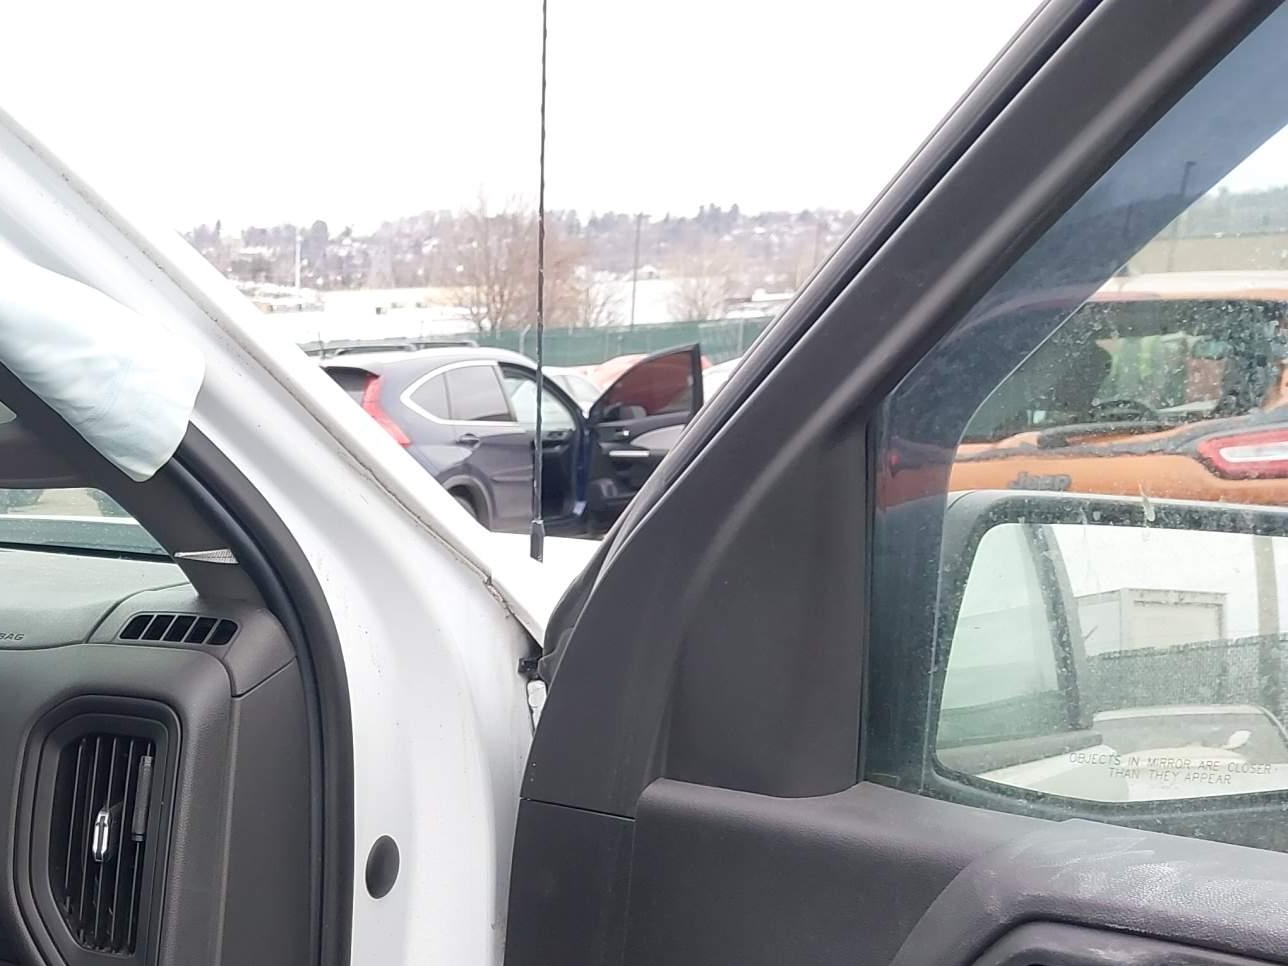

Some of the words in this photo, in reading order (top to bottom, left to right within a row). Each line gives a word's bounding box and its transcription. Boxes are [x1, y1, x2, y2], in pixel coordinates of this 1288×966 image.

[1069, 752, 1121, 766] OBJECTS
[1128, 756, 1140, 767] IN
[1147, 757, 1192, 770] MIRROR
[1198, 760, 1221, 772] ARE
[1227, 762, 1272, 775] CLOSER
[1109, 767, 1140, 779] THAN
[1149, 769, 1180, 782] THEY
[1184, 772, 1232, 785] APPEAR
